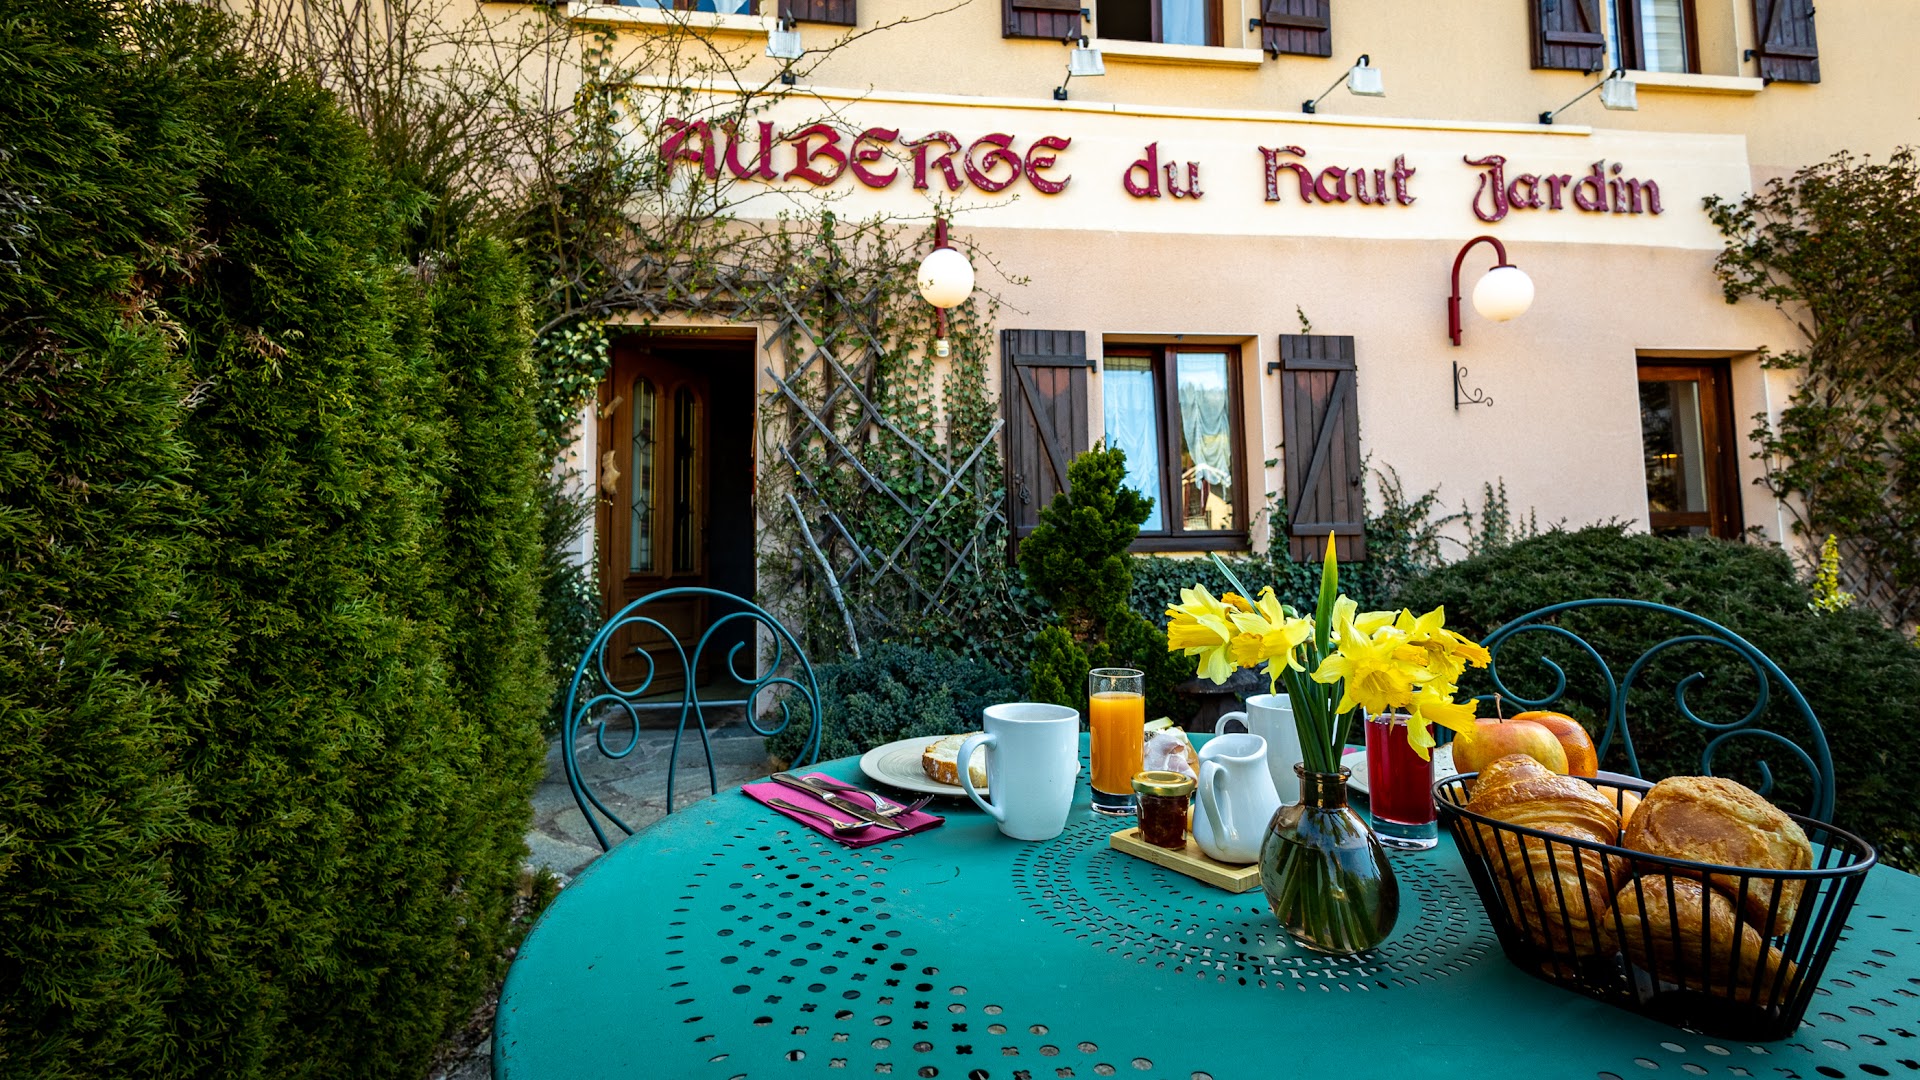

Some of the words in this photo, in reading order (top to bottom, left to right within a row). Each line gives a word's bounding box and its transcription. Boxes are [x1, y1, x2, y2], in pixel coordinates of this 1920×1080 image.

[659, 117, 1073, 195] AUBERGE
[1123, 141, 1204, 199] du
[1463, 154, 1665, 222] Jardin
